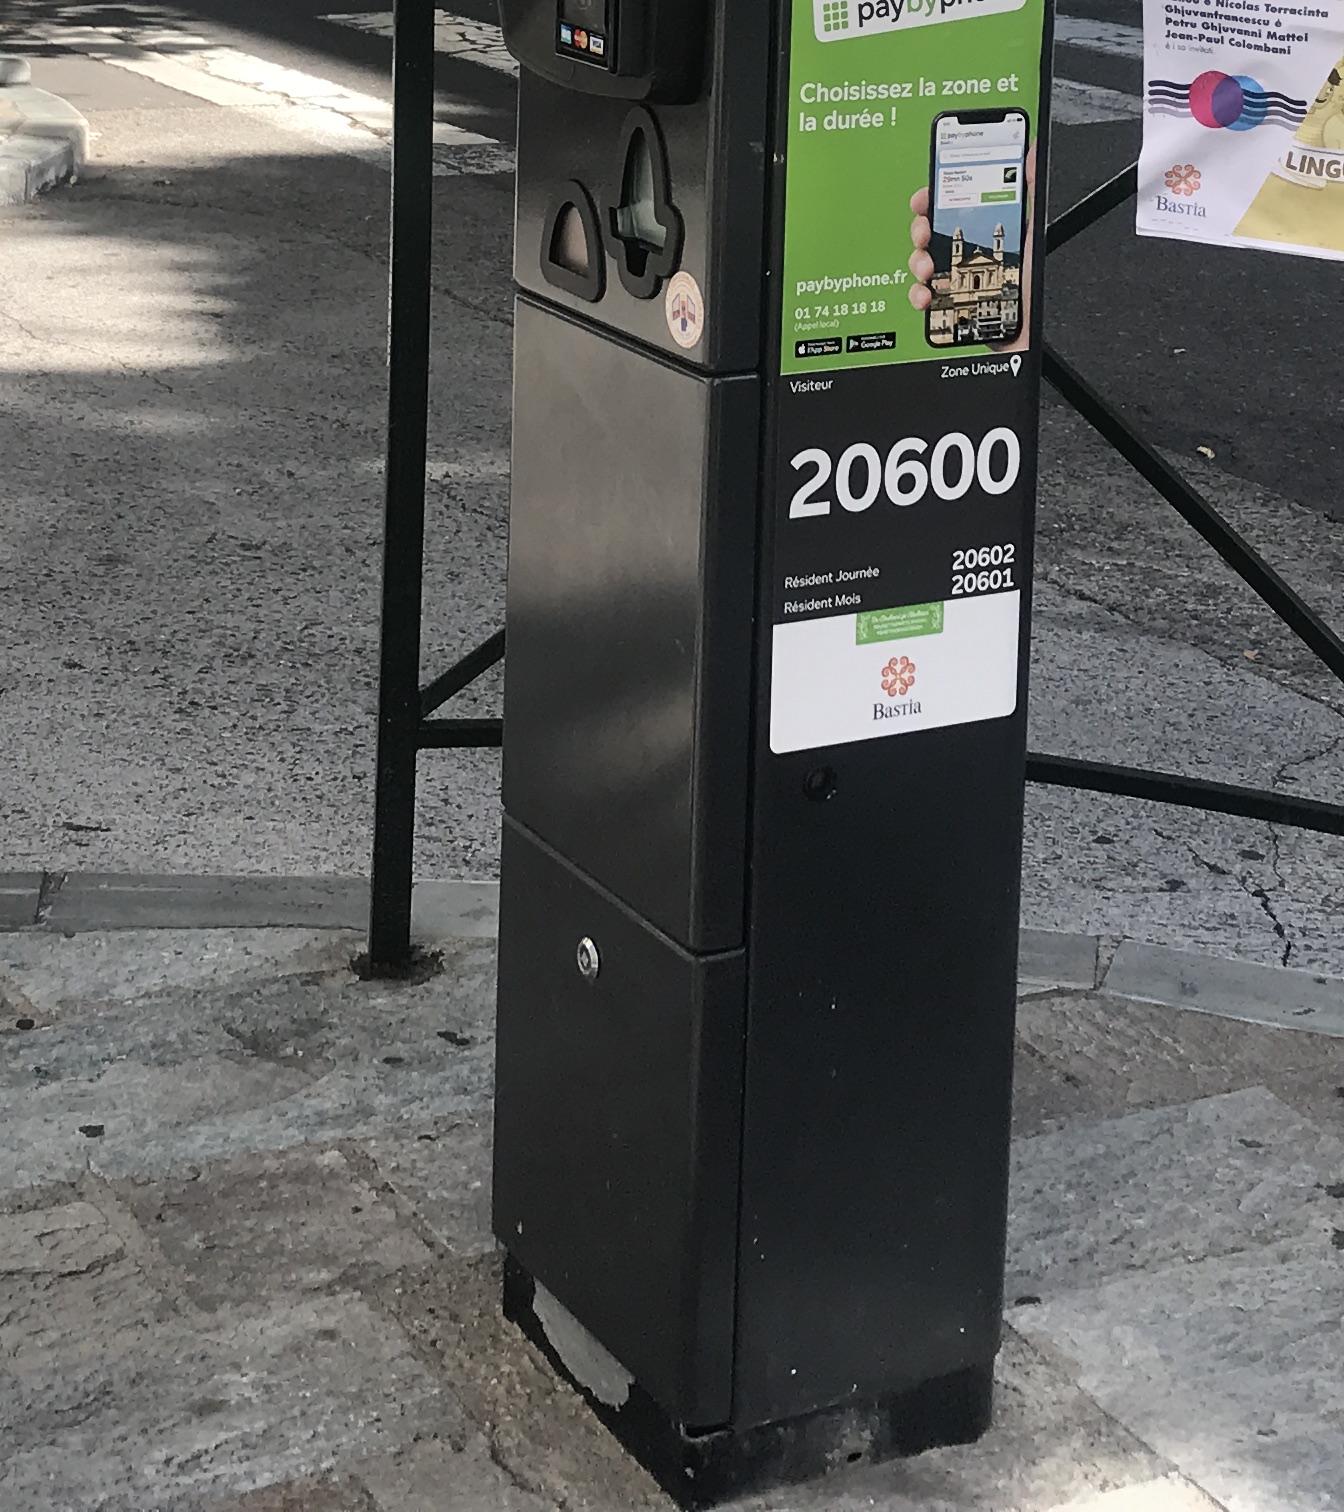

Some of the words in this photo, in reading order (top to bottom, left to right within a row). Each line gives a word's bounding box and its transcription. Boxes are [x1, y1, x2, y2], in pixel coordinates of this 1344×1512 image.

[1164, 4, 1270, 27] Ghjuvanfrancescu
[1264, 2, 1330, 19] Torracinta
[1164, 16, 1197, 30] Petru
[1201, 21, 1263, 39] Ghjuvanni
[1266, 30, 1309, 43] Mattei
[1164, 29, 1225, 45] Jean-Paul
[1228, 37, 1292, 55] Colombani
[799, 80, 913, 104] Choisissez
[918, 77, 936, 98] la
[942, 78, 991, 96] zone
[996, 73, 1020, 93] et
[798, 111, 818, 133] la
[822, 108, 886, 129] durée
[890, 106, 897, 127] !
[1155, 194, 1207, 218] Bastia
[796, 269, 908, 296] paybyphone.fr
[794, 307, 811, 320] 01
[814, 305, 830, 318] 74
[833, 304, 849, 316] 18
[851, 302, 868, 314] 18
[870, 300, 886, 313] 18
[940, 365, 970, 379] Zone
[971, 361, 1010, 375] Unique
[789, 379, 834, 394] Visiteur
[788, 426, 1021, 520] 20600
[952, 543, 1015, 571] 20602
[784, 572, 833, 589] Résident
[835, 565, 880, 583] Journée
[951, 567, 1015, 595] 20601
[783, 597, 833, 614] Résident
[835, 593, 862, 607] Mois
[872, 698, 922, 721] Bastia
